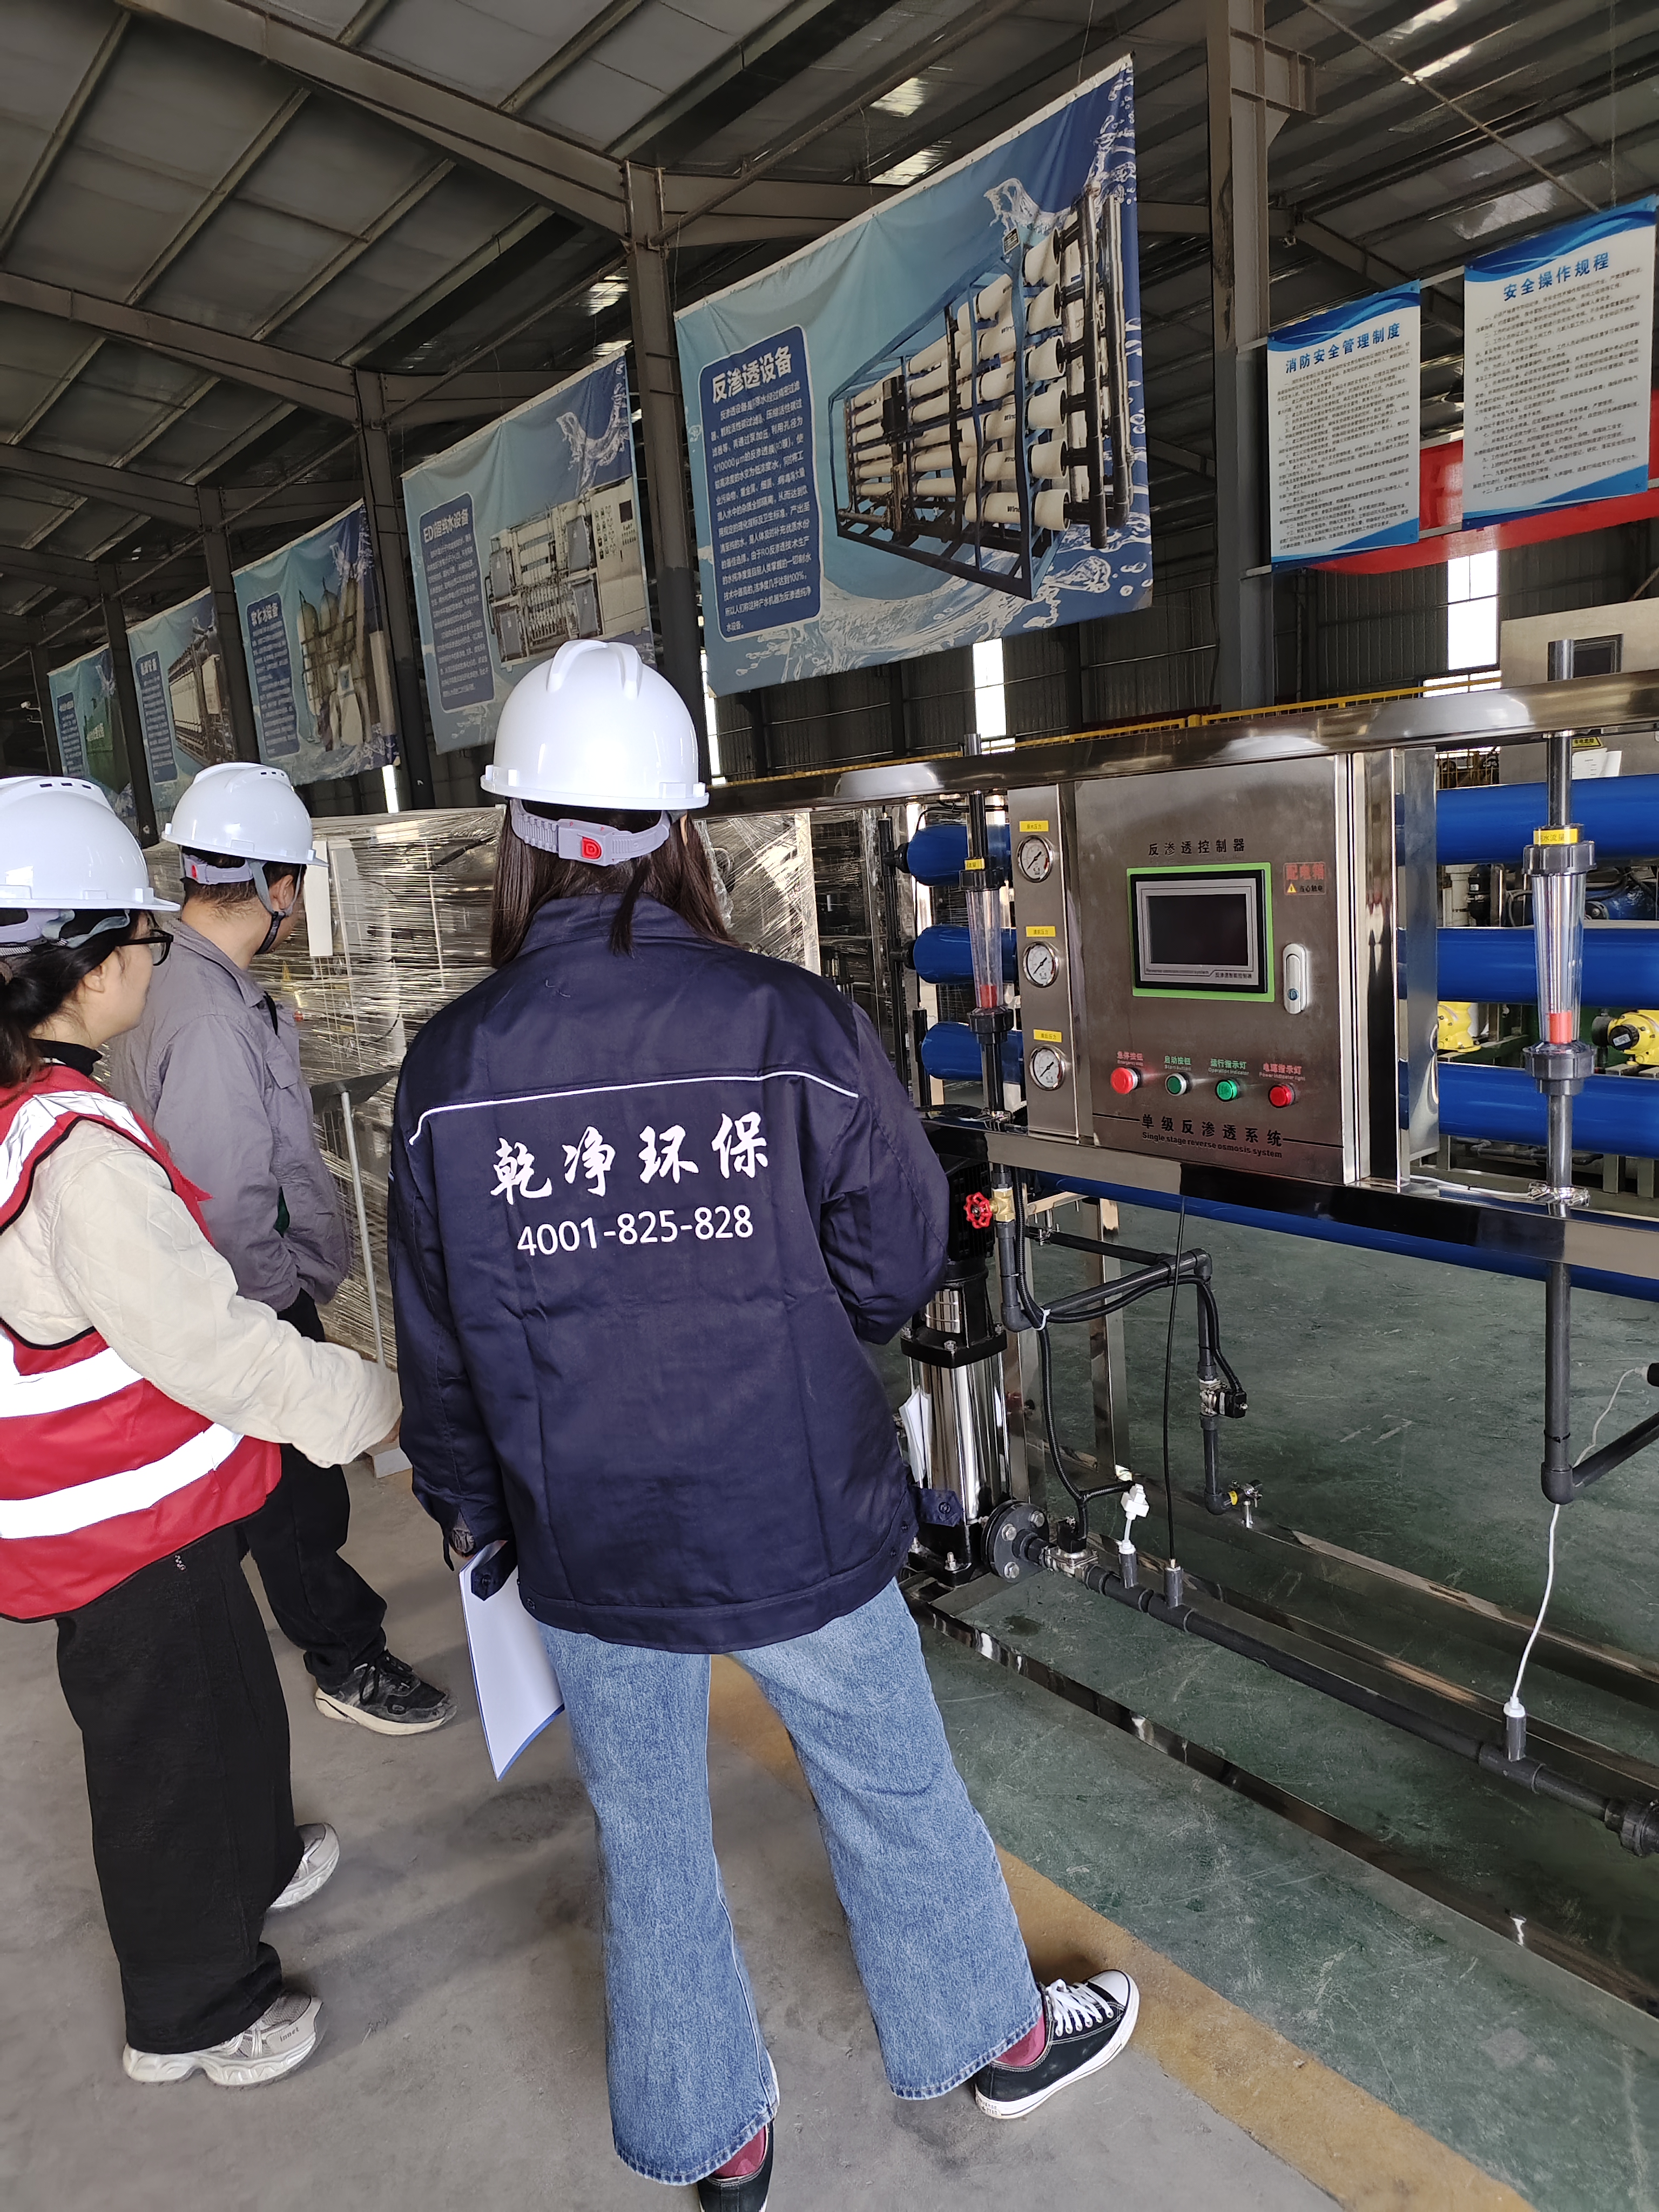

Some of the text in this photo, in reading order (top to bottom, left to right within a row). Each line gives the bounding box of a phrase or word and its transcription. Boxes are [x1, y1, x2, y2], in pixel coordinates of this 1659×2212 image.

[1503, 252, 1609, 302] 安全操作规程
[1285, 323, 1400, 374] 消防安全管理制度
[712, 345, 792, 404] 反渗透设备
[1148, 838, 1245, 856] 反渗透控制器
[1164, 1055, 1191, 1065] 启动按钮
[1210, 1058, 1247, 1070] 运行指示灯
[1141, 1114, 1283, 1147] 单级反渗透系统
[1142, 1131, 1283, 1159] Single stage reverse osmosis system
[490, 1111, 769, 1205] 乾净环保
[517, 1205, 753, 1256] 4001-825-828
